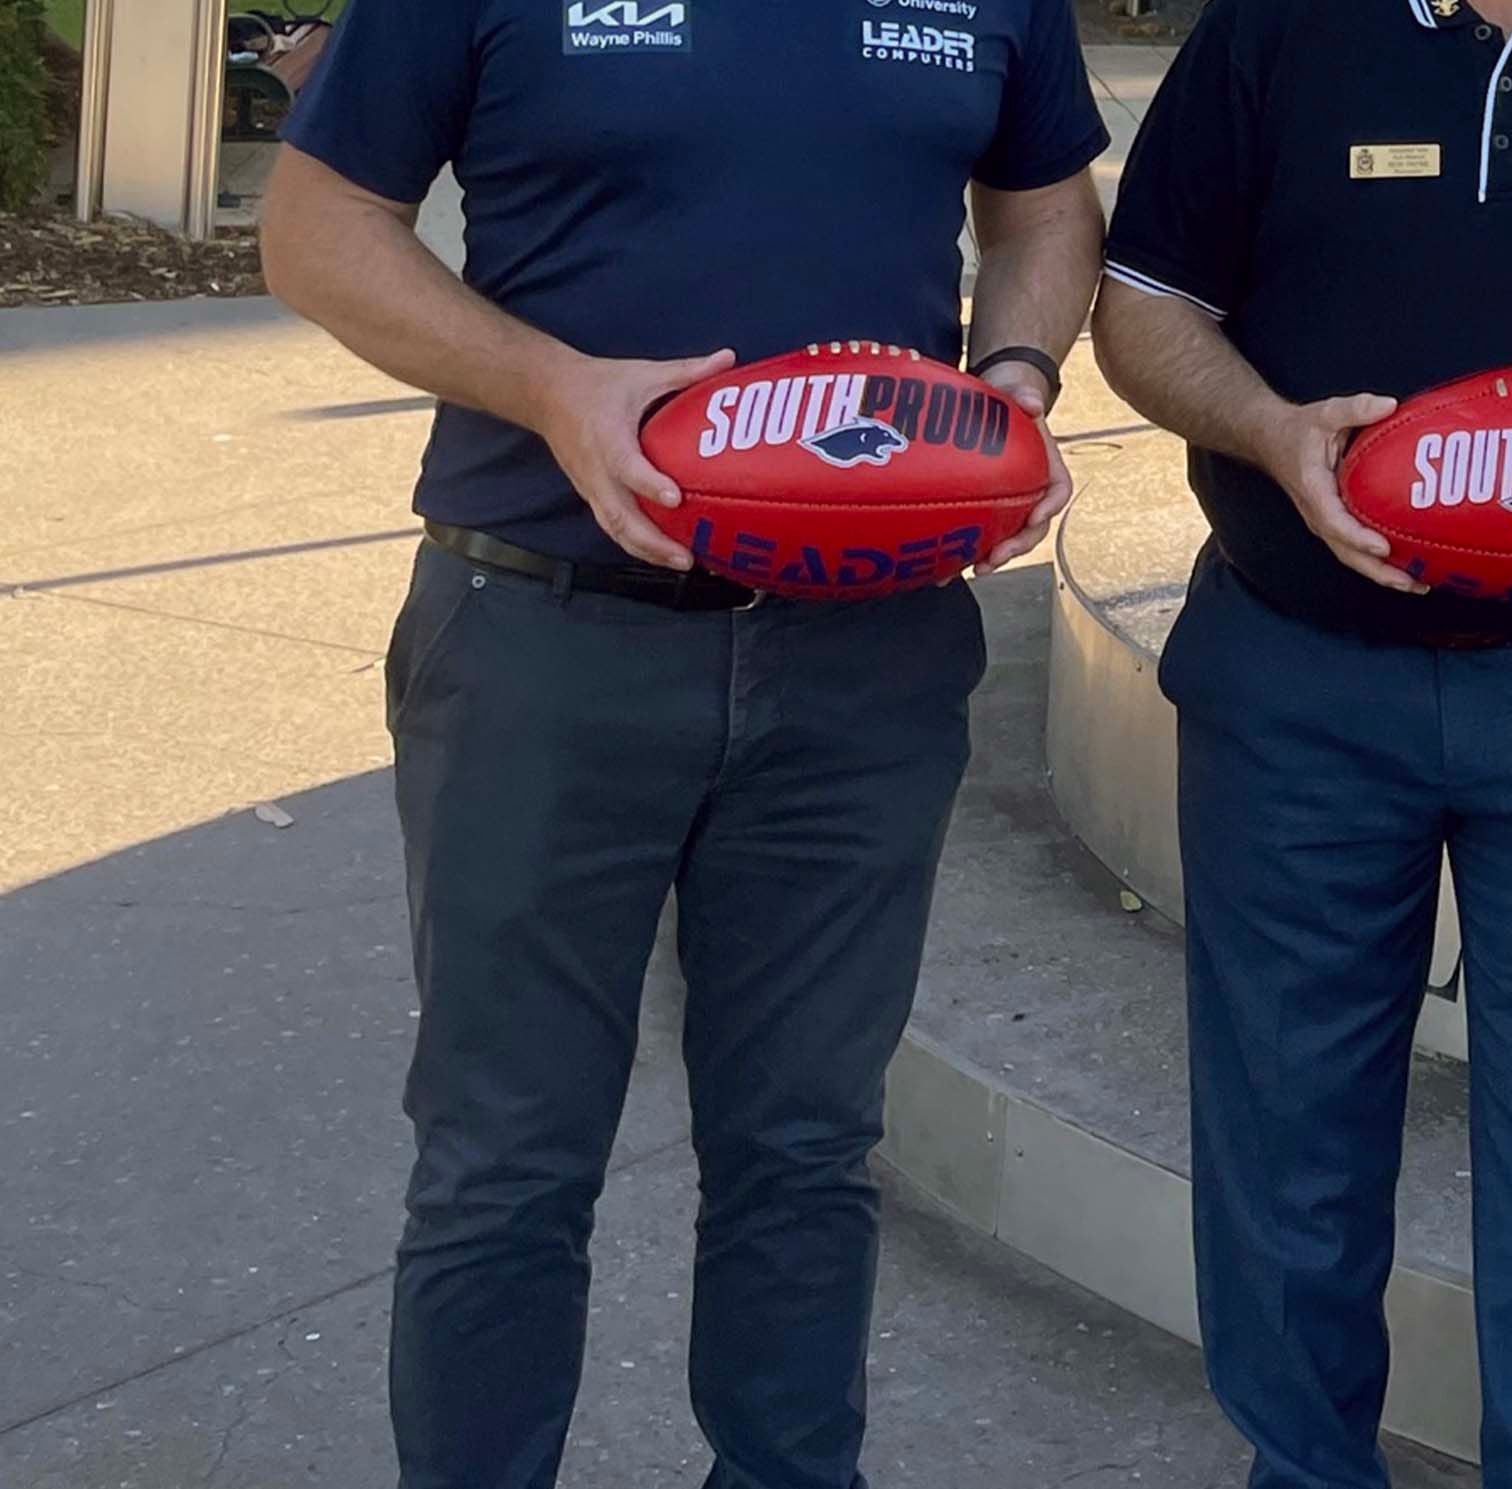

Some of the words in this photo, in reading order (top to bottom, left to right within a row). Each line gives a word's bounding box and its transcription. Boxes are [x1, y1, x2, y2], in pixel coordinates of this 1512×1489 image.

[571, 31, 630, 49] Wayne
[633, 31, 683, 46] Phillis
[863, 20, 974, 59] LEADER
[863, 47, 974, 72] COMPUTERS
[692, 518, 983, 587] LEADER
